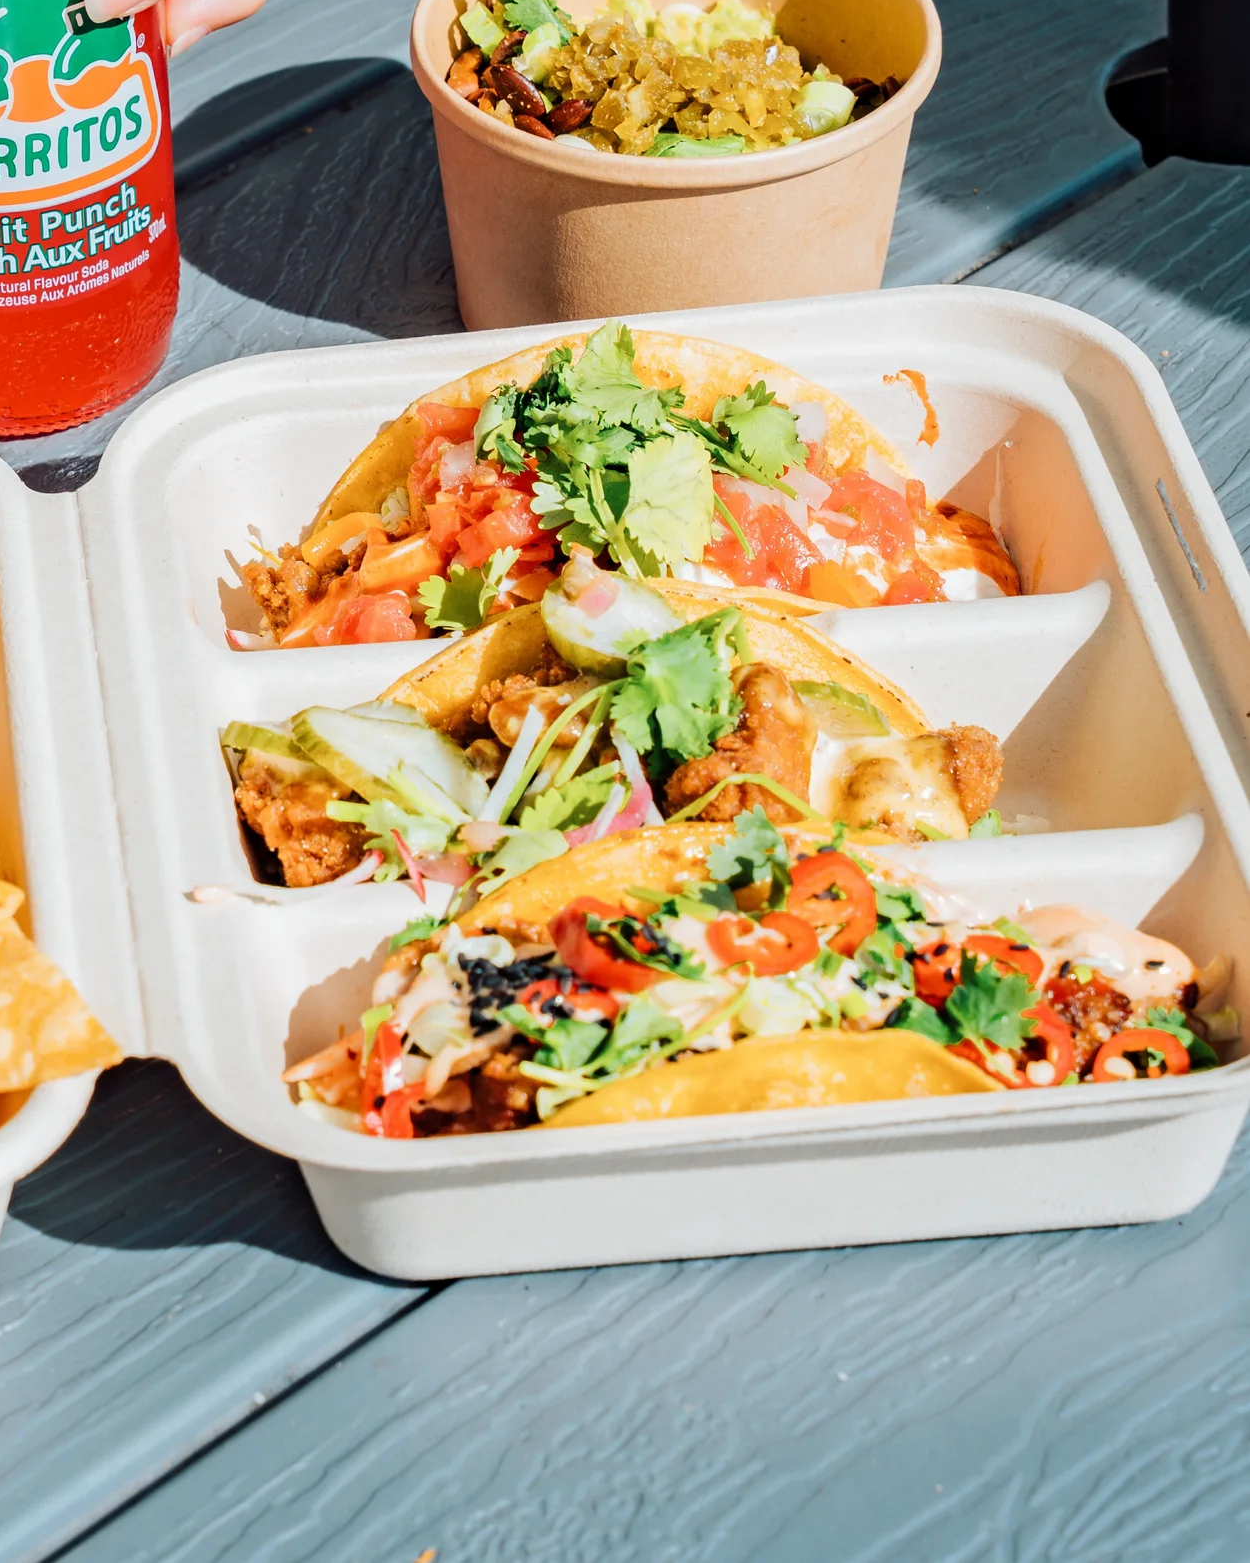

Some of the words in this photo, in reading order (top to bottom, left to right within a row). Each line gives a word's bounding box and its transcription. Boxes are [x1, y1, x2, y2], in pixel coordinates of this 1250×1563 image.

[22, 239, 86, 273] Aux
[88, 204, 152, 257] Fruits
[40, 181, 136, 240] Punch
[34, 271, 79, 291] Flavour
[81, 259, 110, 278] Soda
[40, 289, 65, 303] Aux
[67, 273, 110, 297] Arômes
[111, 249, 150, 280] Naturels
